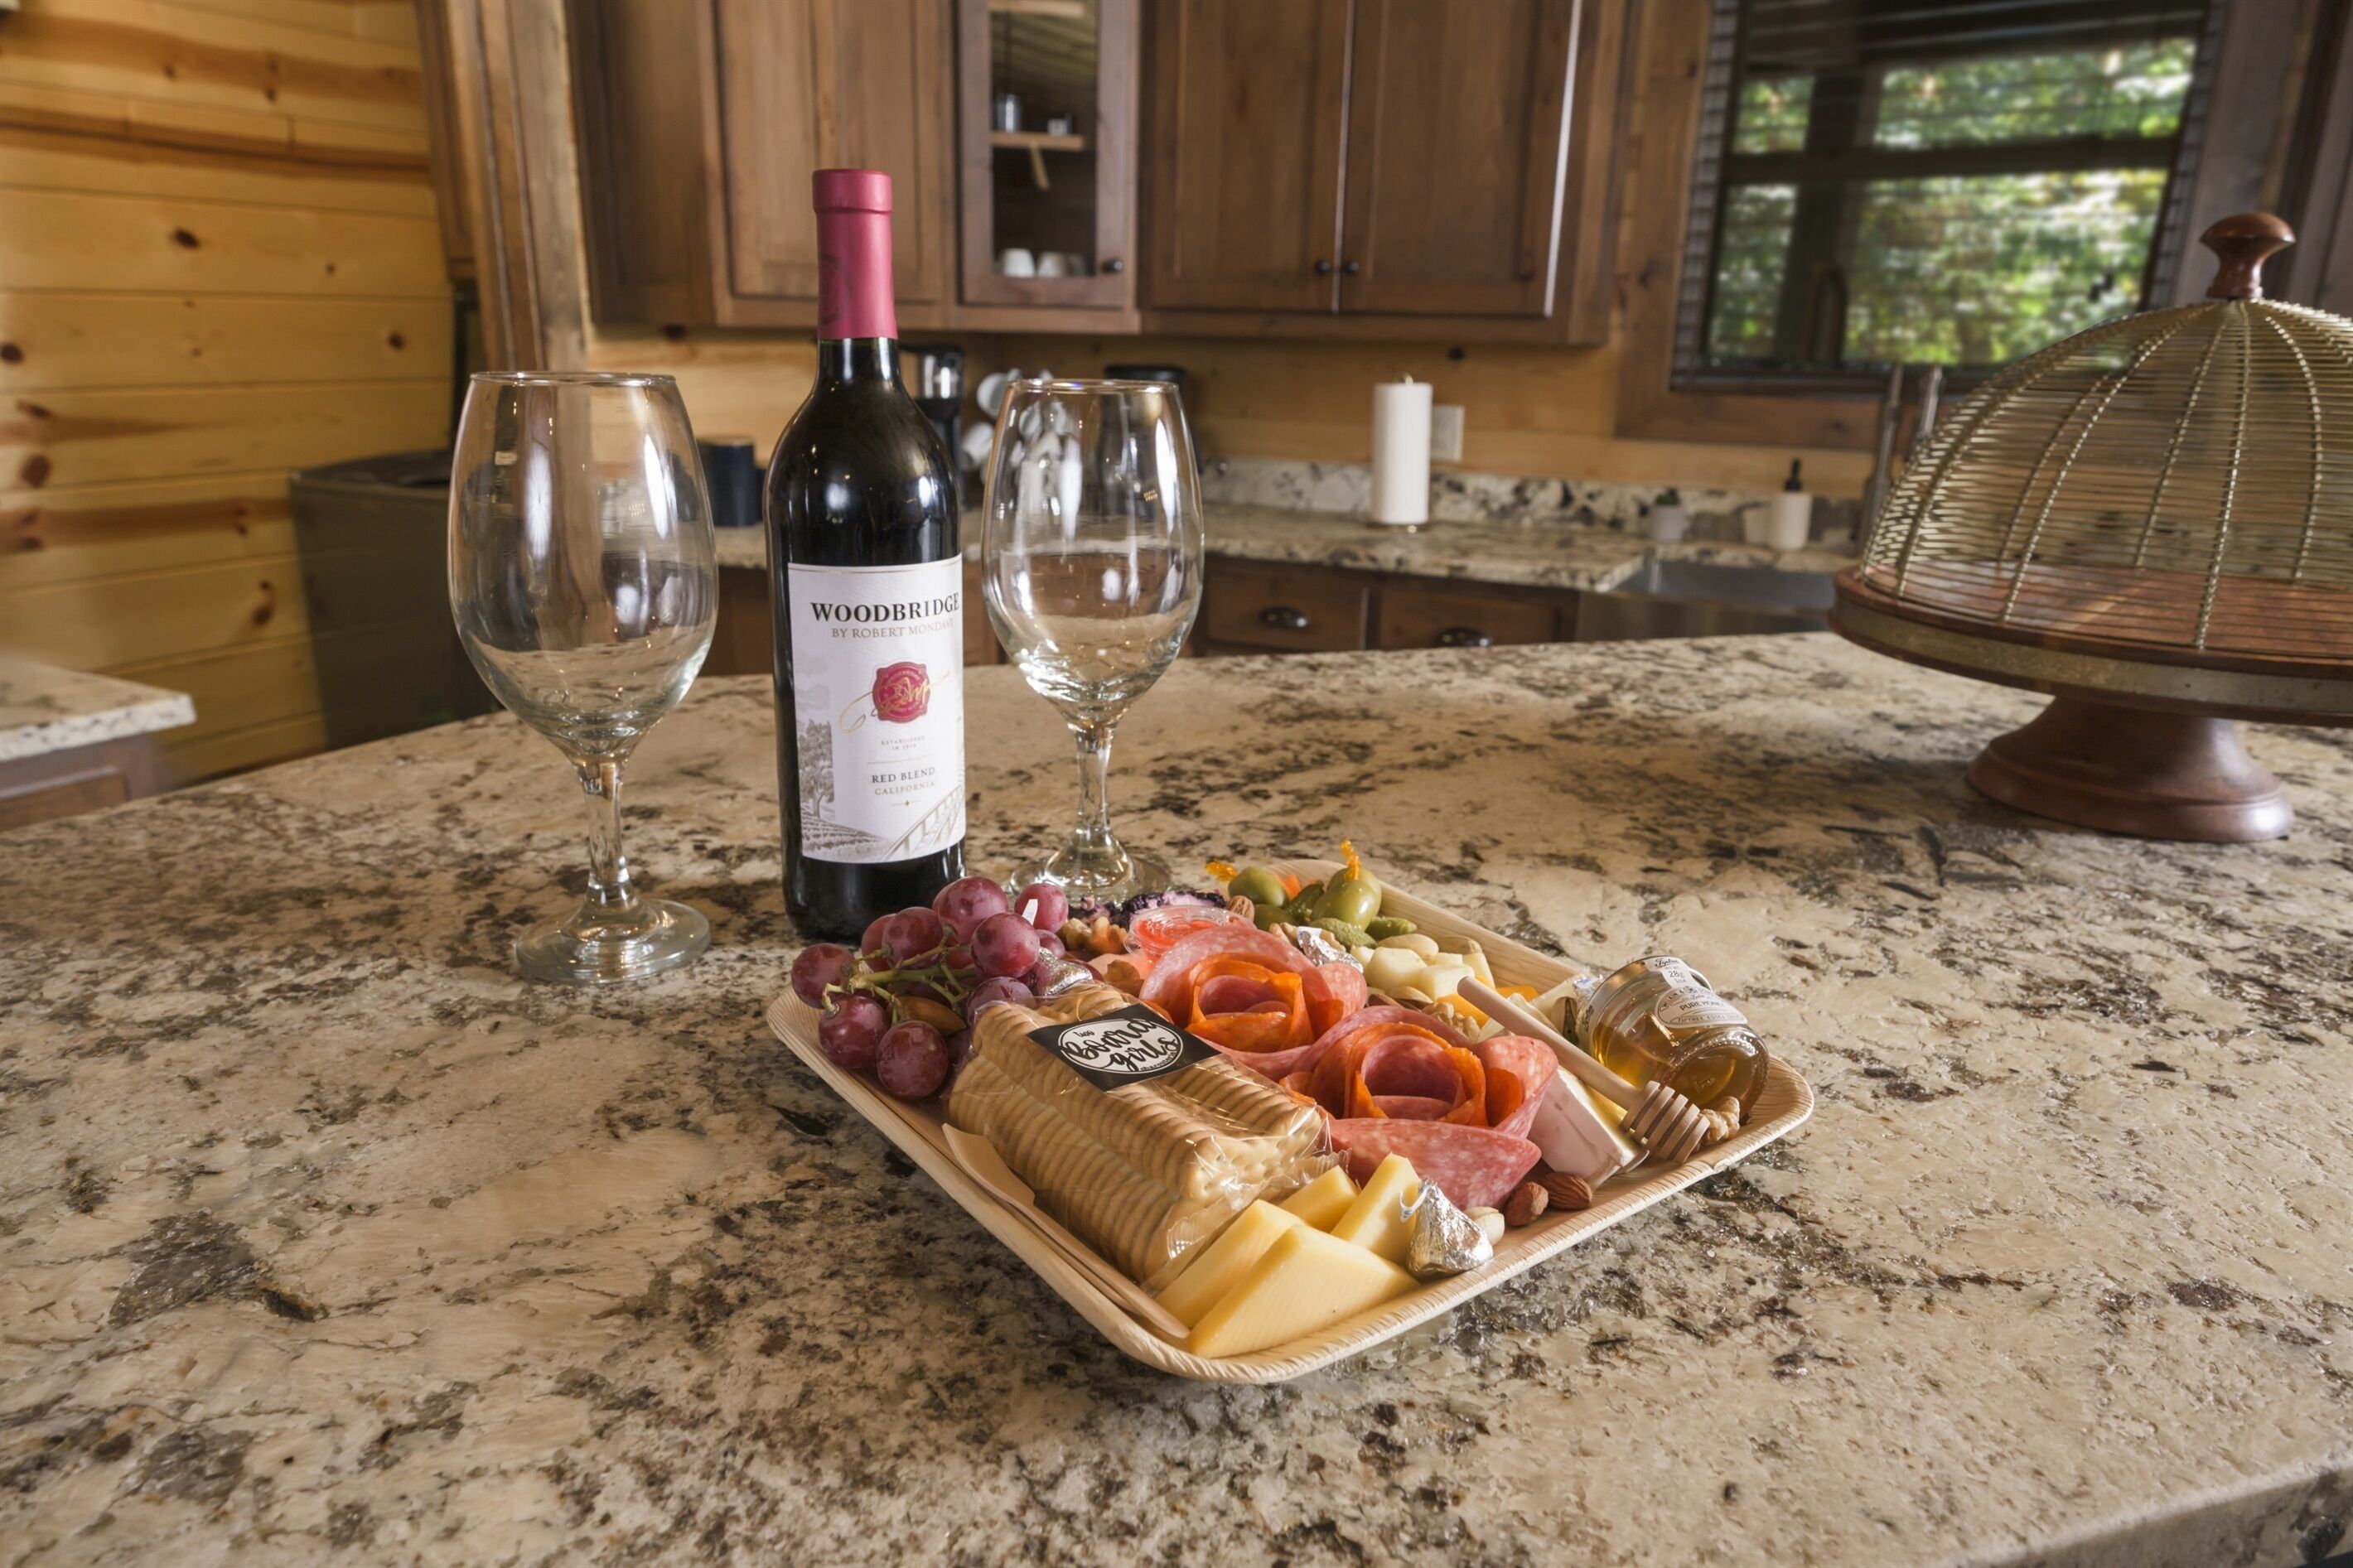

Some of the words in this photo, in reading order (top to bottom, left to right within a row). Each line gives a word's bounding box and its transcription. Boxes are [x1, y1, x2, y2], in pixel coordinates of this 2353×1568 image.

[810, 592, 959, 622] WOODBRIDGE
[832, 628, 848, 638] BY
[852, 626, 905, 638] ROBERT
[872, 774, 896, 784] RED
[901, 766, 935, 781] BLEND
[874, 780, 935, 796] CALIFORNIA
[1679, 1001, 1700, 1011] PURE
